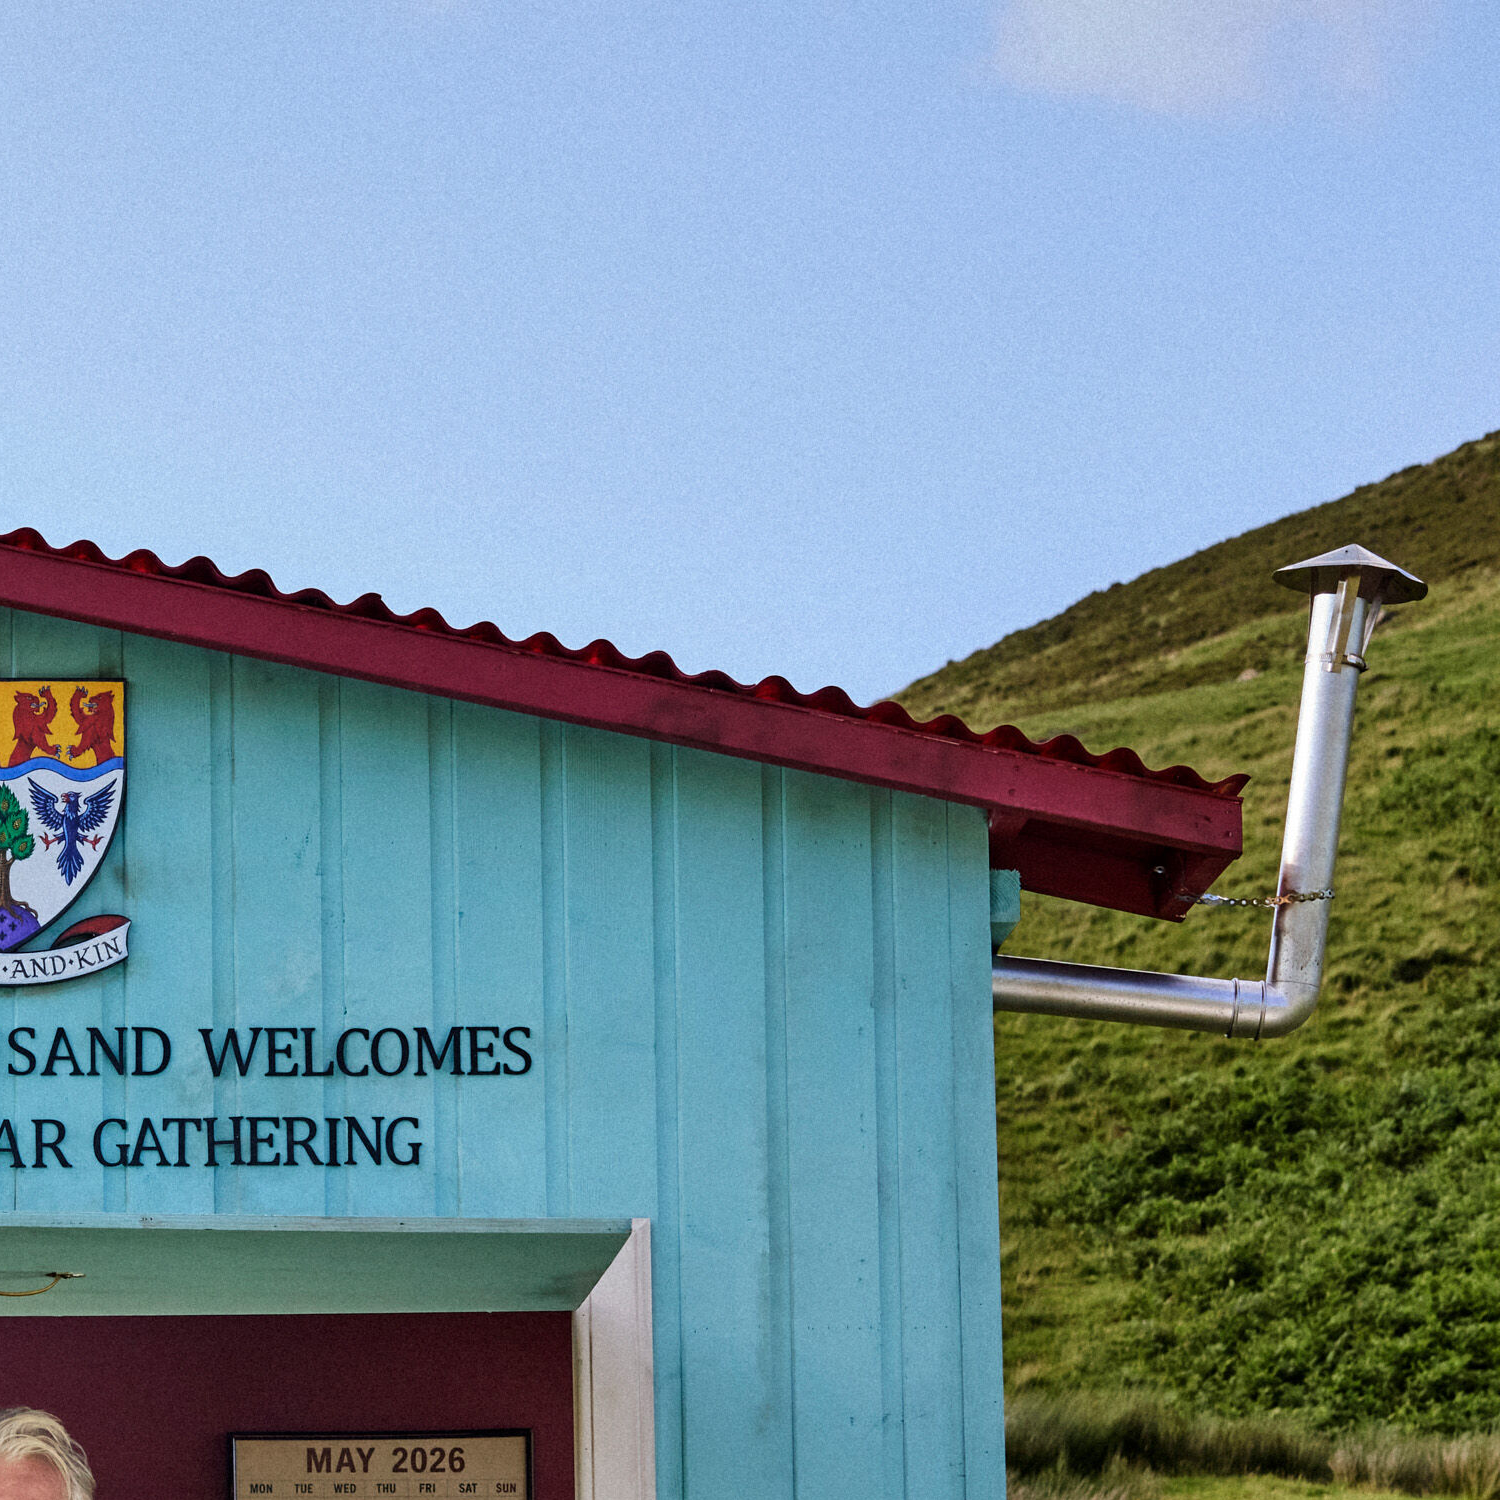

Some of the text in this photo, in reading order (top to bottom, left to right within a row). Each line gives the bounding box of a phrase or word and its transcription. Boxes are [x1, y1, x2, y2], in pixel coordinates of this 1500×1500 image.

[198, 1027, 532, 1078] WELCOMES
[93, 1116, 422, 1169] GATHERING
[307, 1447, 465, 1473] MAY 2026
[250, 1483, 516, 1493] MON TUE WED THU FRI SAT SUN
